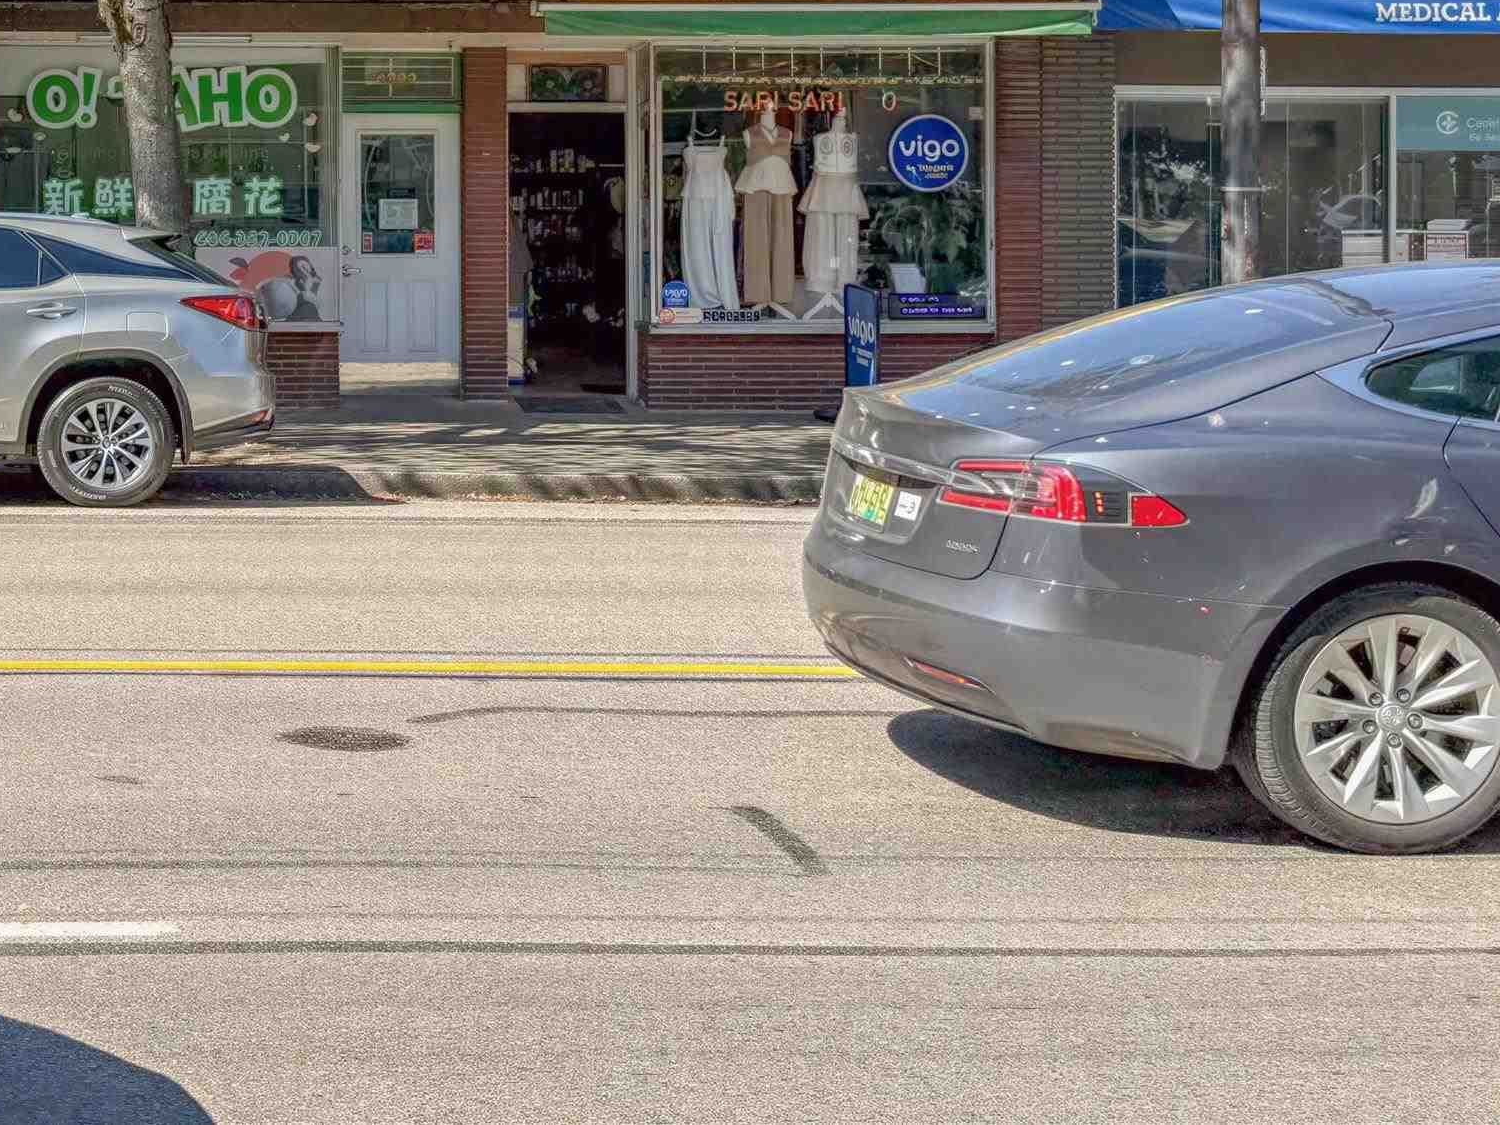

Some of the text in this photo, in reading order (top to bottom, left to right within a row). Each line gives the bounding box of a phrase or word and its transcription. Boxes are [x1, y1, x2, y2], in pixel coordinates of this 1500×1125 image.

[1375, 2, 1492, 22] MEDICAL
[724, 90, 779, 111] SARI
[788, 90, 844, 112] SARI
[899, 134, 960, 162] vigo
[43, 177, 283, 216] 新鮮腐花
